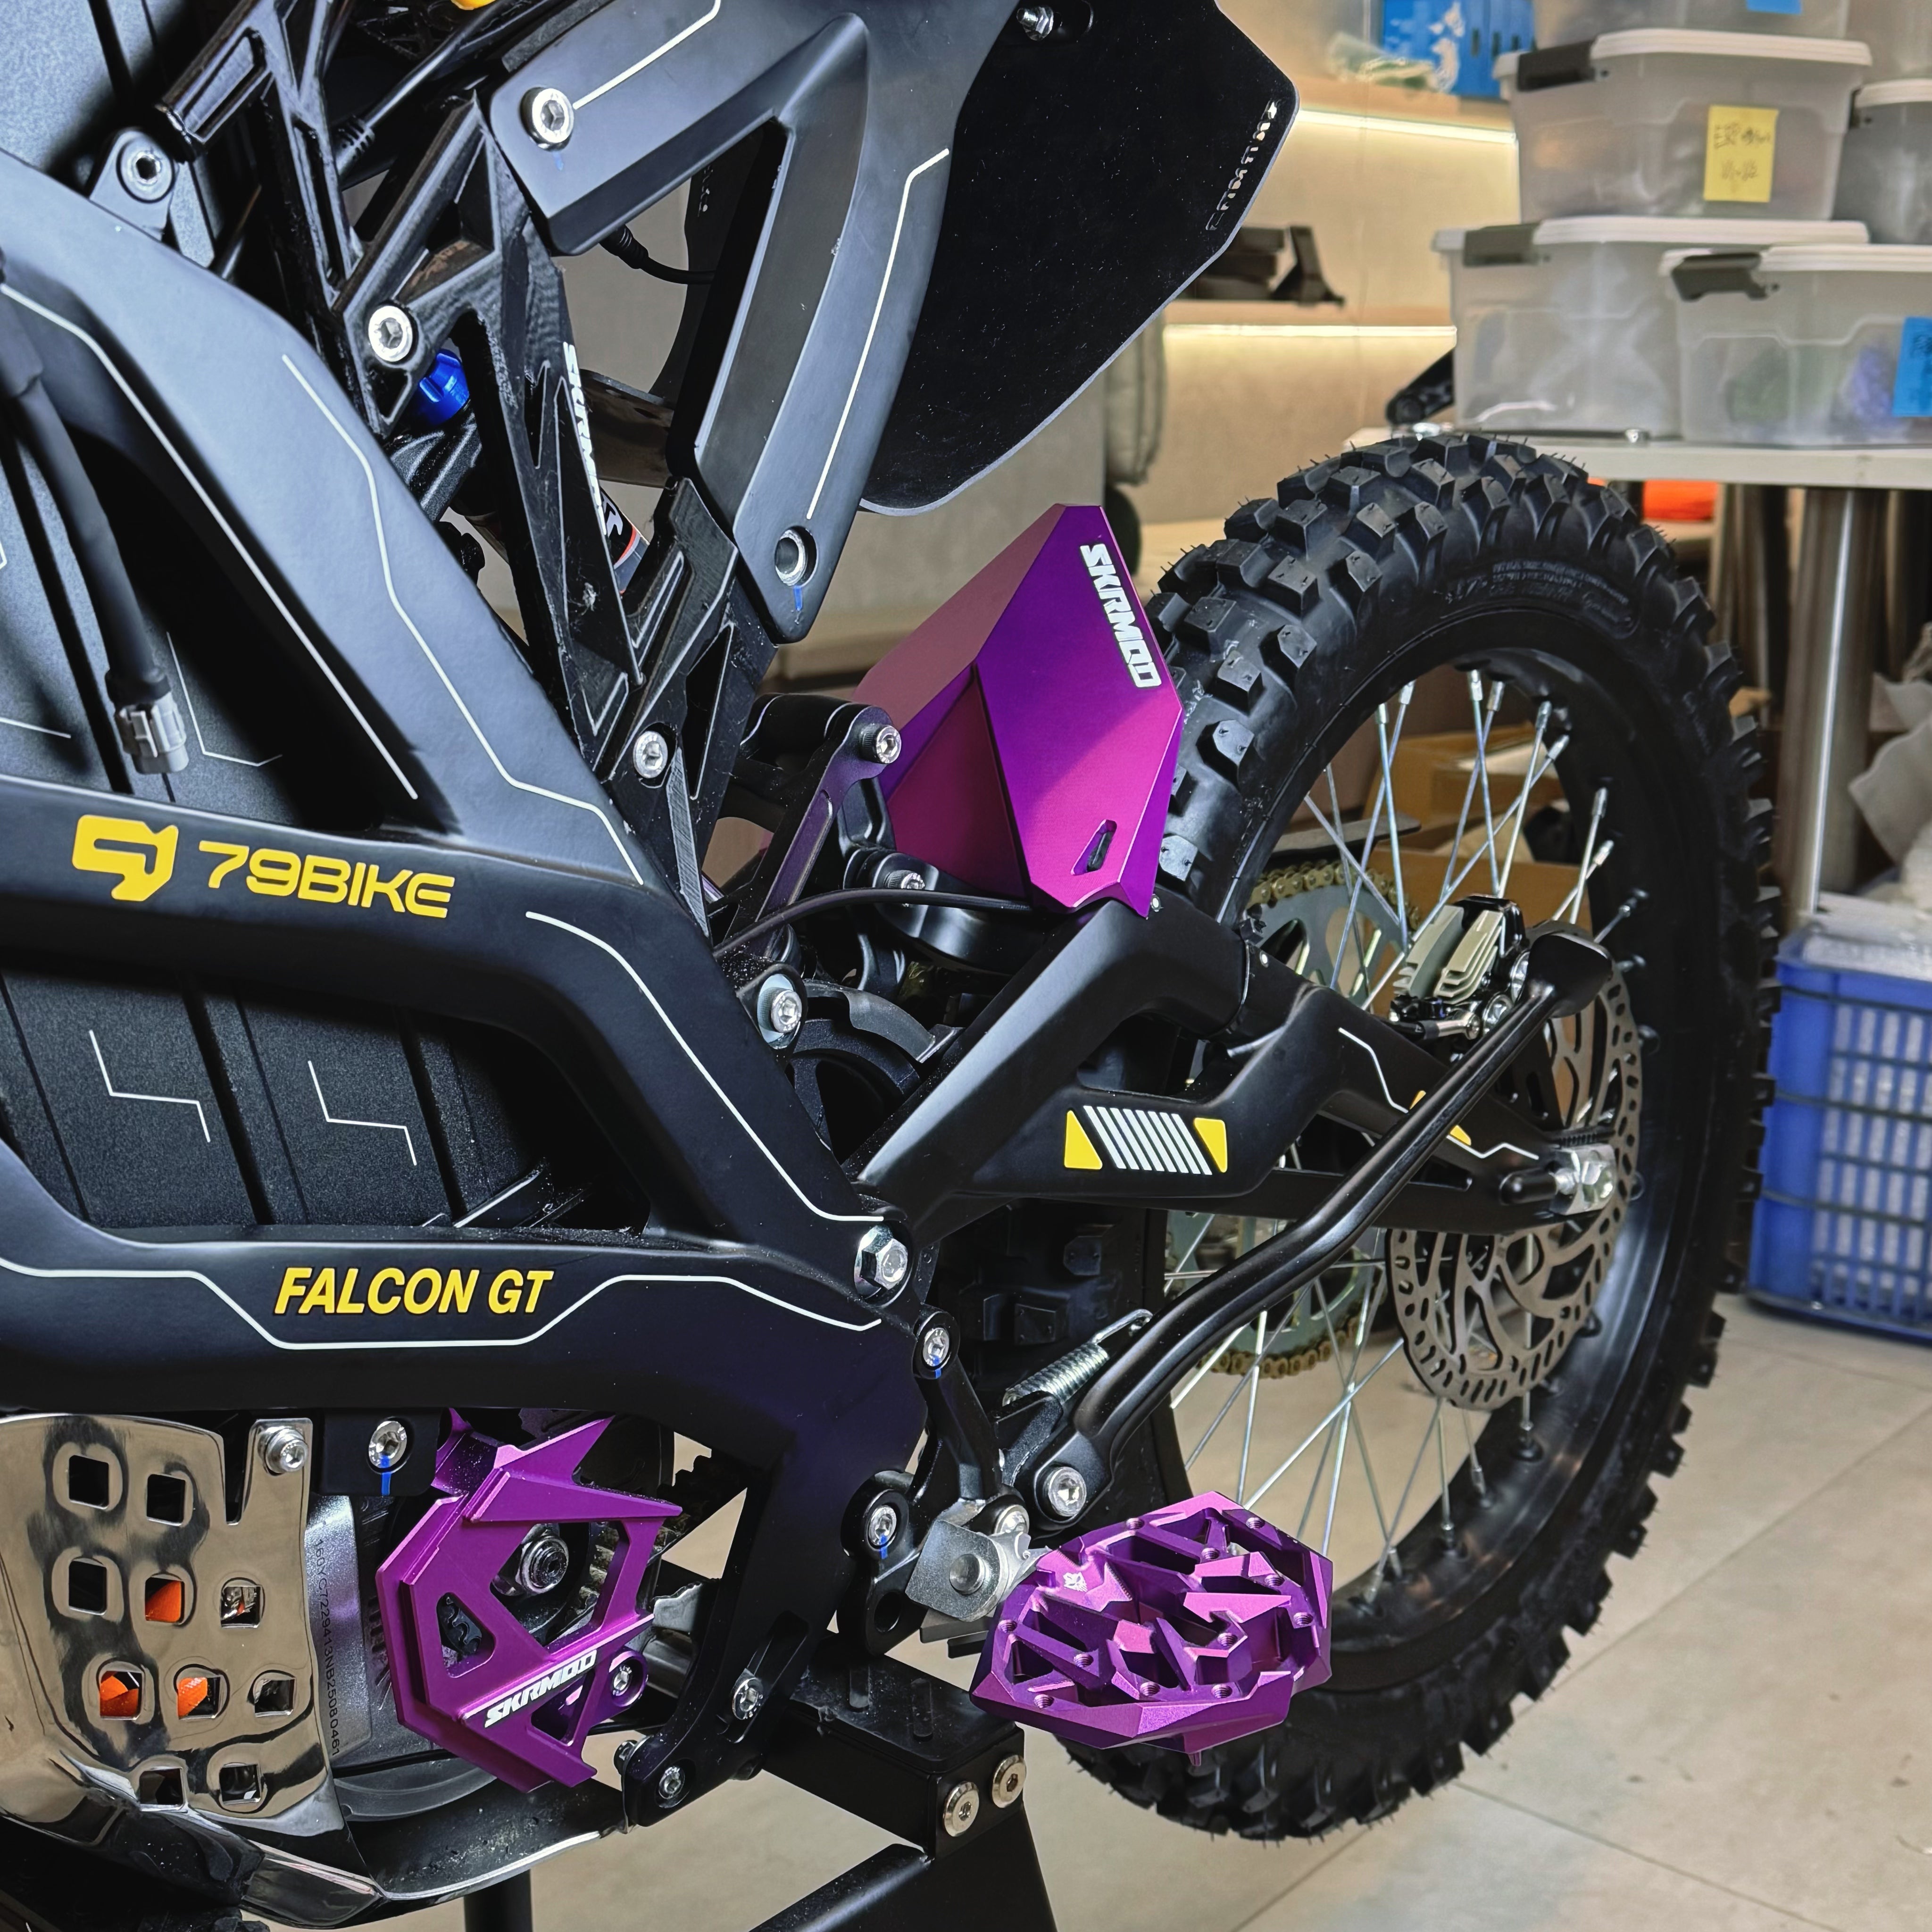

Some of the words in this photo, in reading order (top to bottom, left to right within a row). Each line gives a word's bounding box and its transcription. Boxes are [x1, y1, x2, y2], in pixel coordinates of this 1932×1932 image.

[199, 841, 455, 918] 79BIKE
[275, 1267, 478, 1314] FALCON
[488, 1269, 554, 1314] GT
[484, 1649, 598, 1728] SKRMOD
